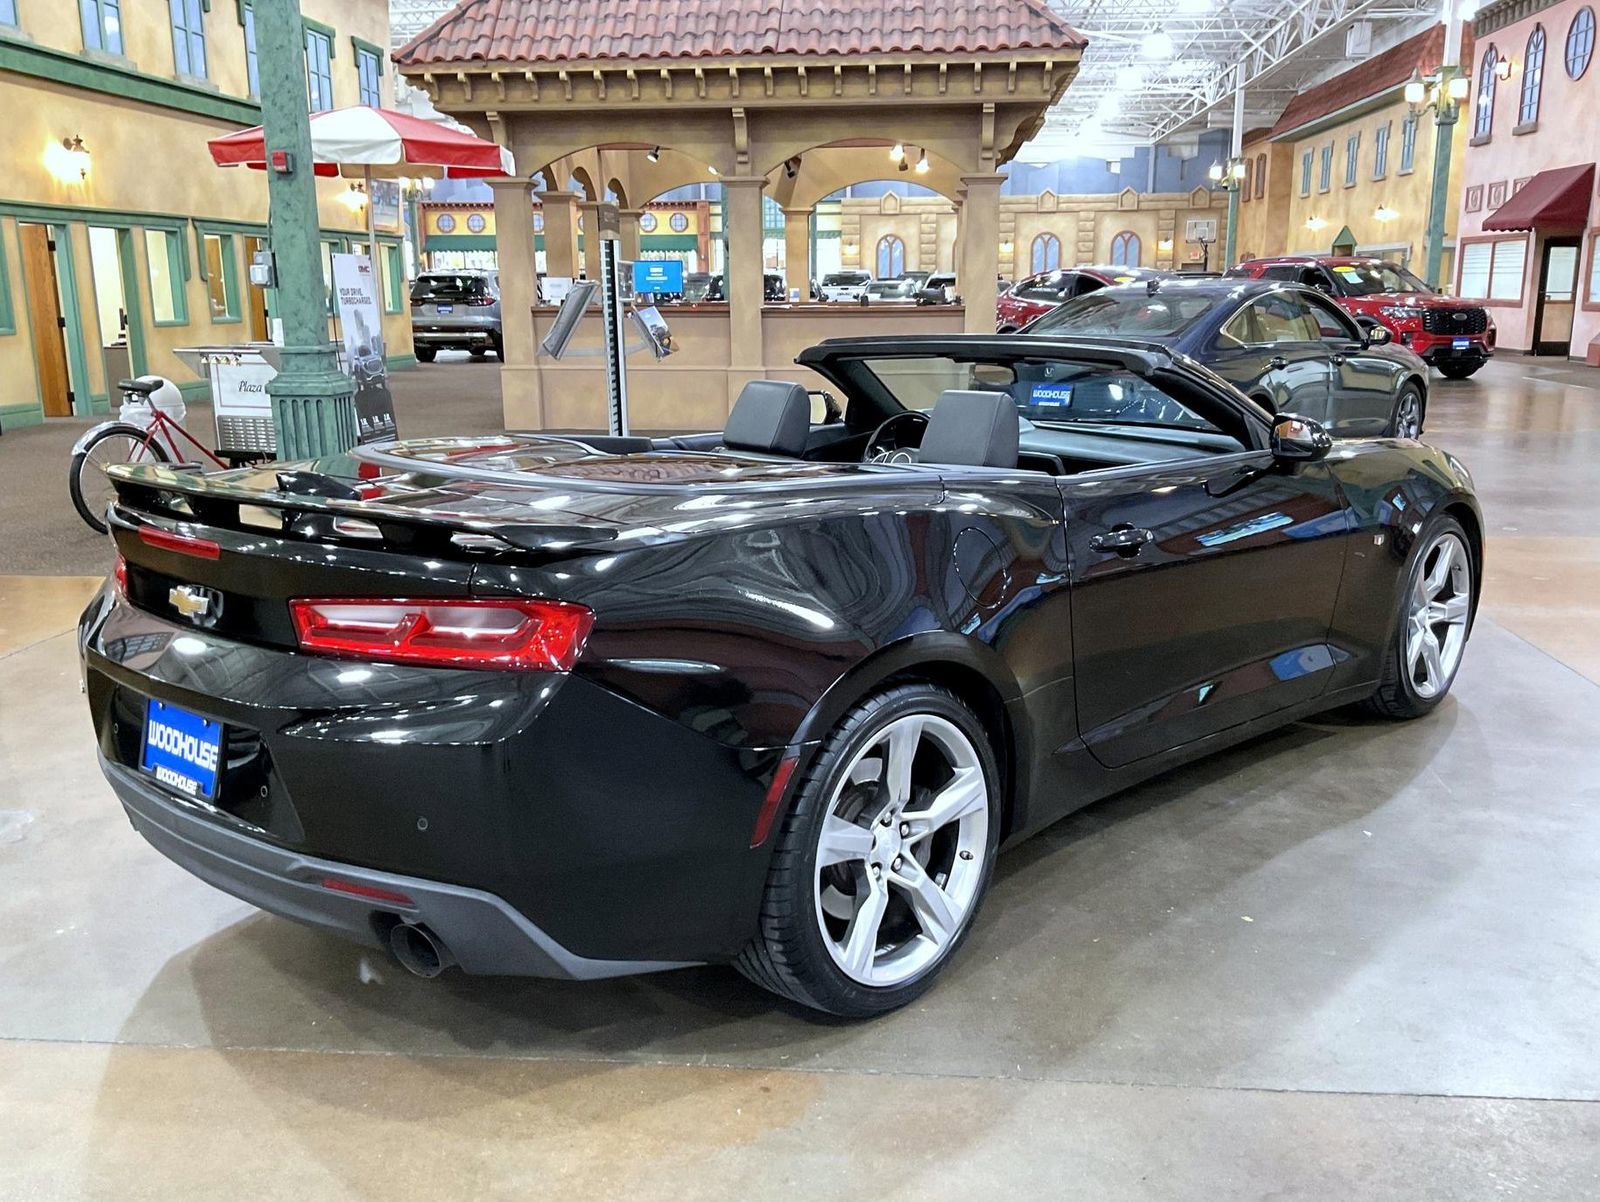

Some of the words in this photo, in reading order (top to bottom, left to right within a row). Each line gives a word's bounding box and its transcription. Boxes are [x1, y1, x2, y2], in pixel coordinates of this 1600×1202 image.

[239, 381, 262, 393] Plaza
[1033, 390, 1070, 399] WOODHOUSE
[148, 720, 218, 772] WOODHOUSE
[156, 765, 198, 796] WOODHOUSE
